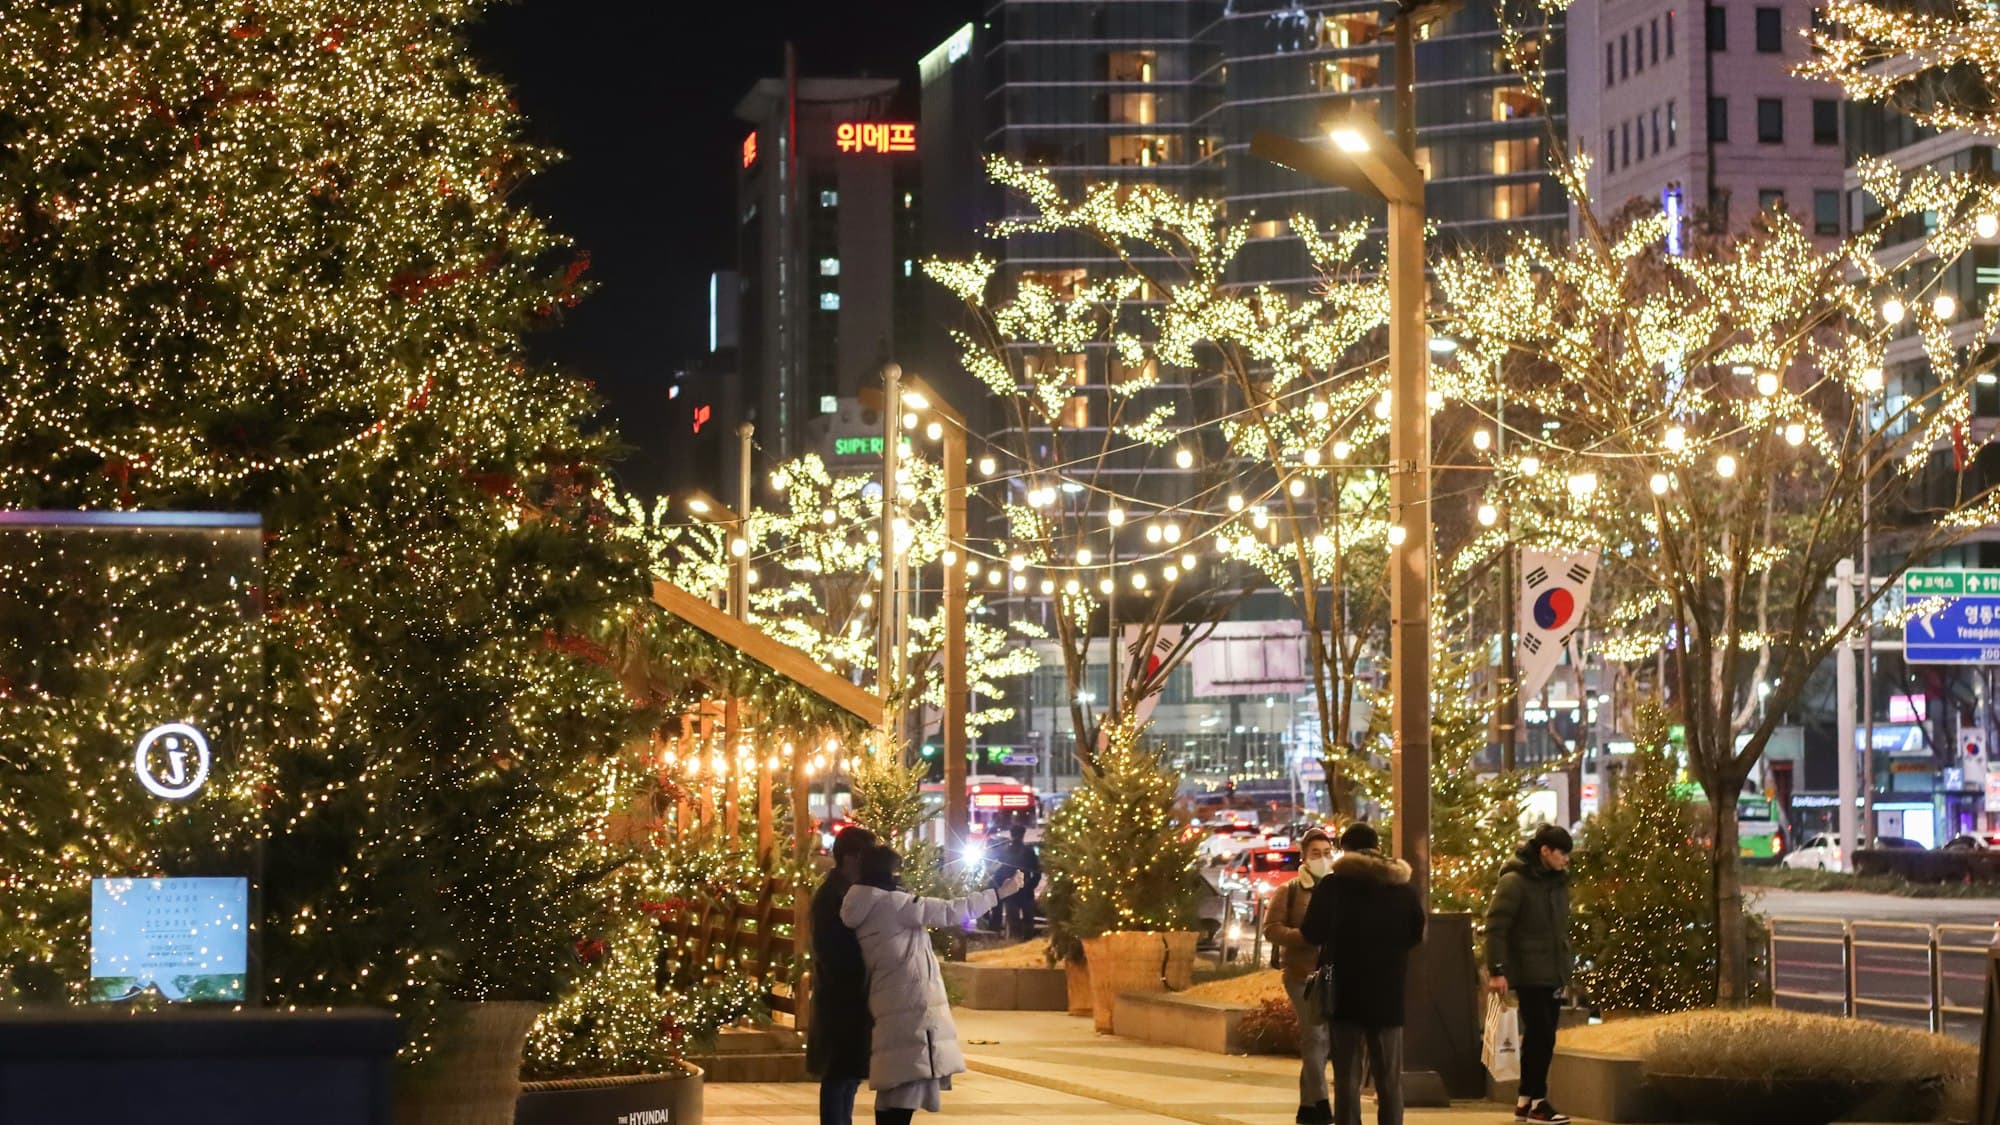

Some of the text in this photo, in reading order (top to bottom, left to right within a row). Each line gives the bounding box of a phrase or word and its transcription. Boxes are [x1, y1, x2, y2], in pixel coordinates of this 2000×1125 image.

[837, 123, 916, 152] 위메프
[835, 437, 884, 455] SUPER
[629, 1109, 669, 1125] HYUNDAI
